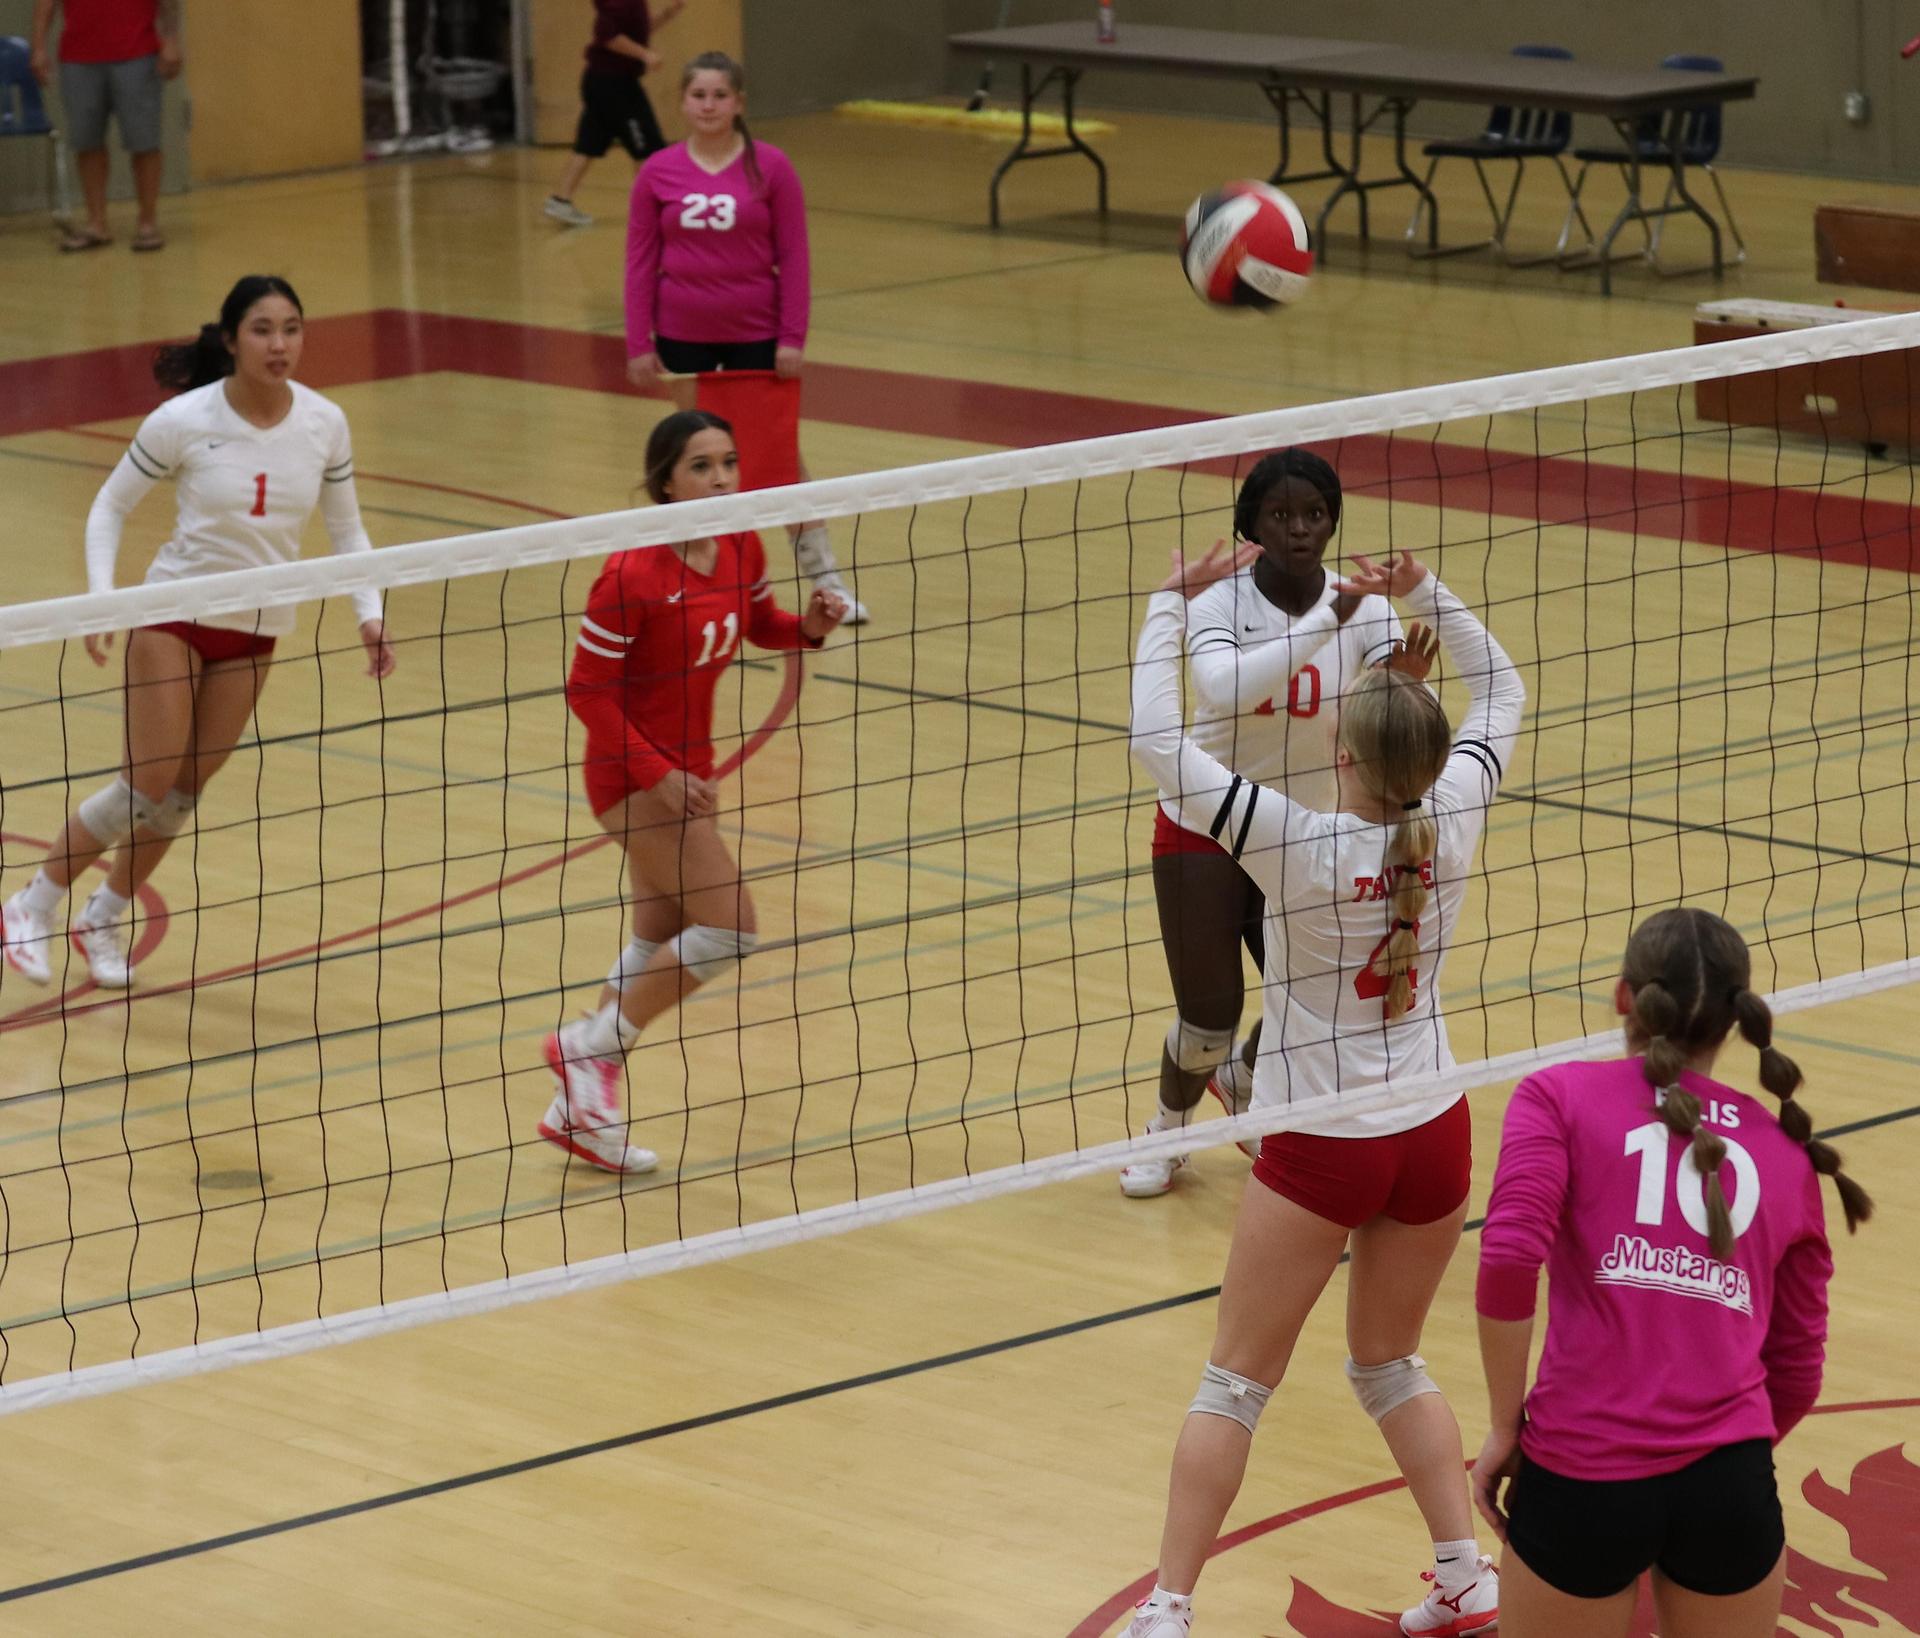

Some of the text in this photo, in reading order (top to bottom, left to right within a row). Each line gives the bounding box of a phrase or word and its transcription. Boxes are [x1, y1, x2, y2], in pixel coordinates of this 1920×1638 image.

[680, 193, 736, 231] 23
[249, 471, 268, 517] 1
[694, 612, 738, 667] 11
[1254, 664, 1321, 719] 0
[1623, 1121, 1761, 1240] 10
[1600, 1233, 1751, 1300] Mustangs
